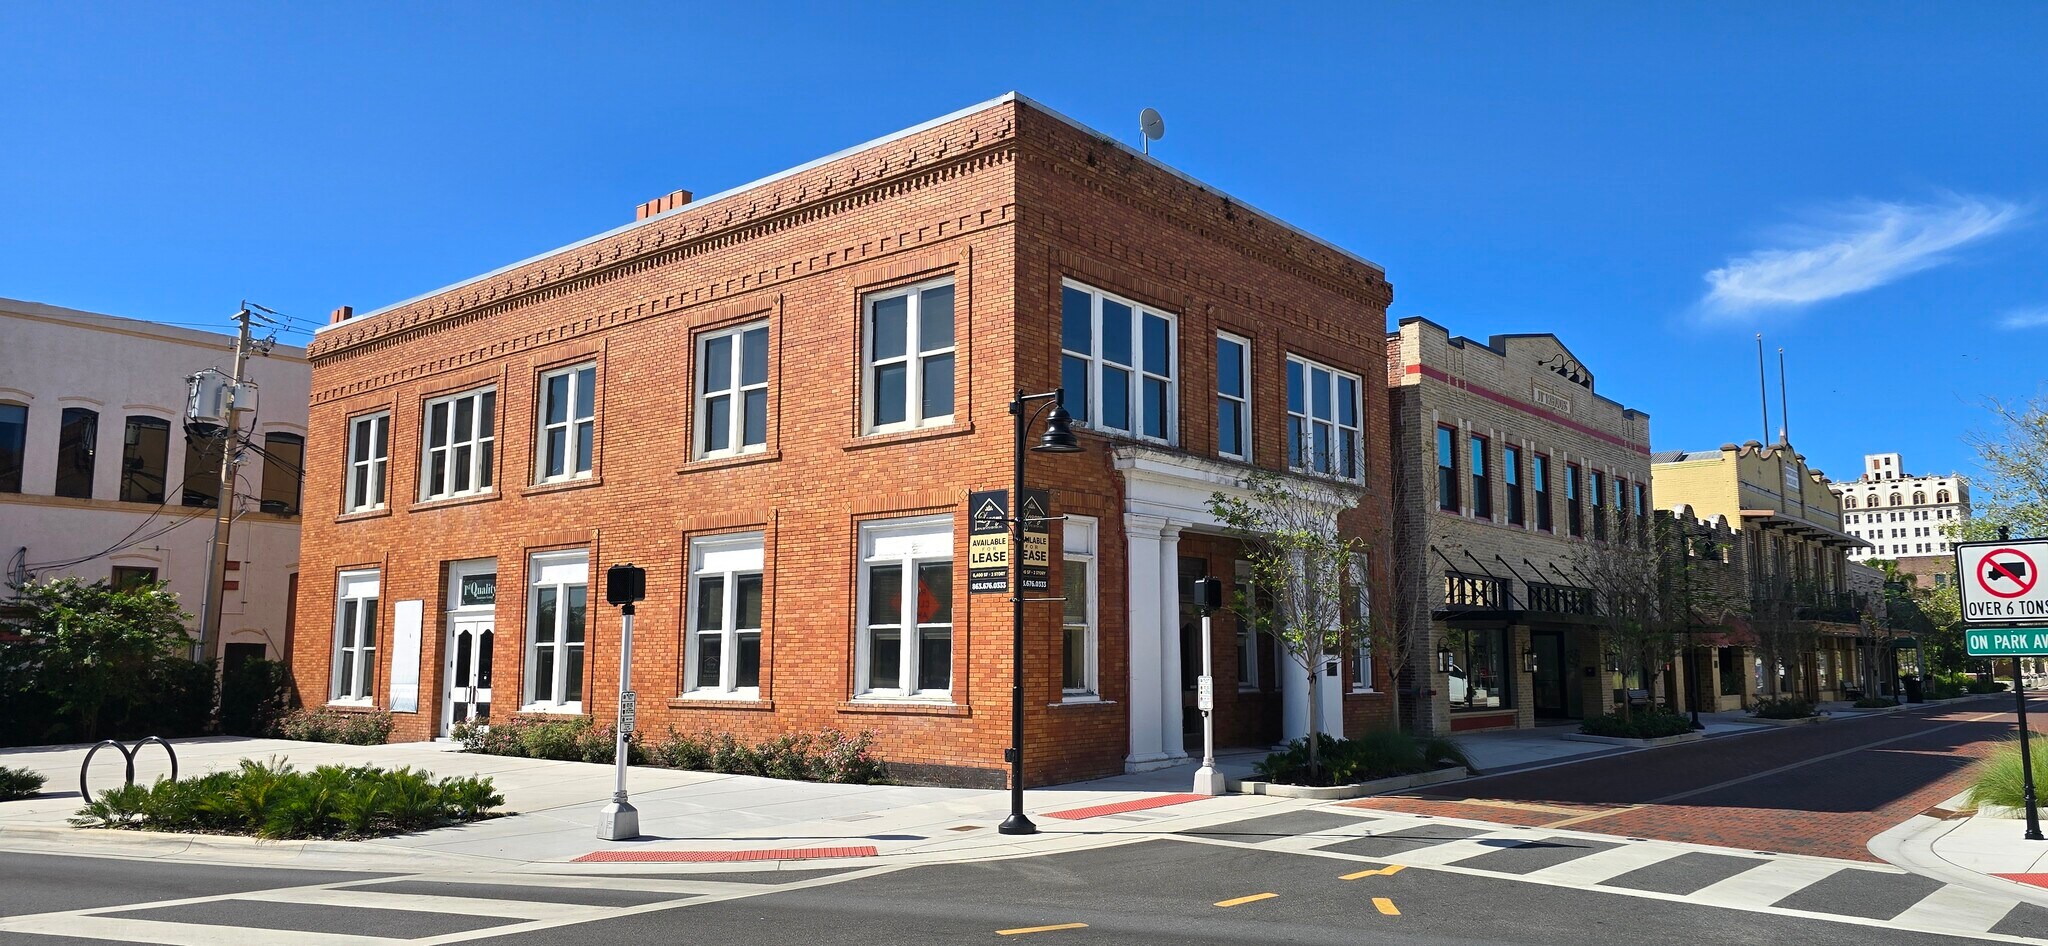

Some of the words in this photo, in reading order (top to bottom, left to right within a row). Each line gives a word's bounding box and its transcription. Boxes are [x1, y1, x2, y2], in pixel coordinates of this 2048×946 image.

[972, 537, 1006, 547] AVAILABLE
[972, 551, 1006, 563] LEASE
[1024, 550, 1047, 562] EASE
[471, 581, 496, 597] Quality
[1969, 601, 2002, 616] OVER
[2006, 601, 2014, 615] 6
[1970, 635, 1988, 650] ON
[1994, 634, 2029, 650] PARK
